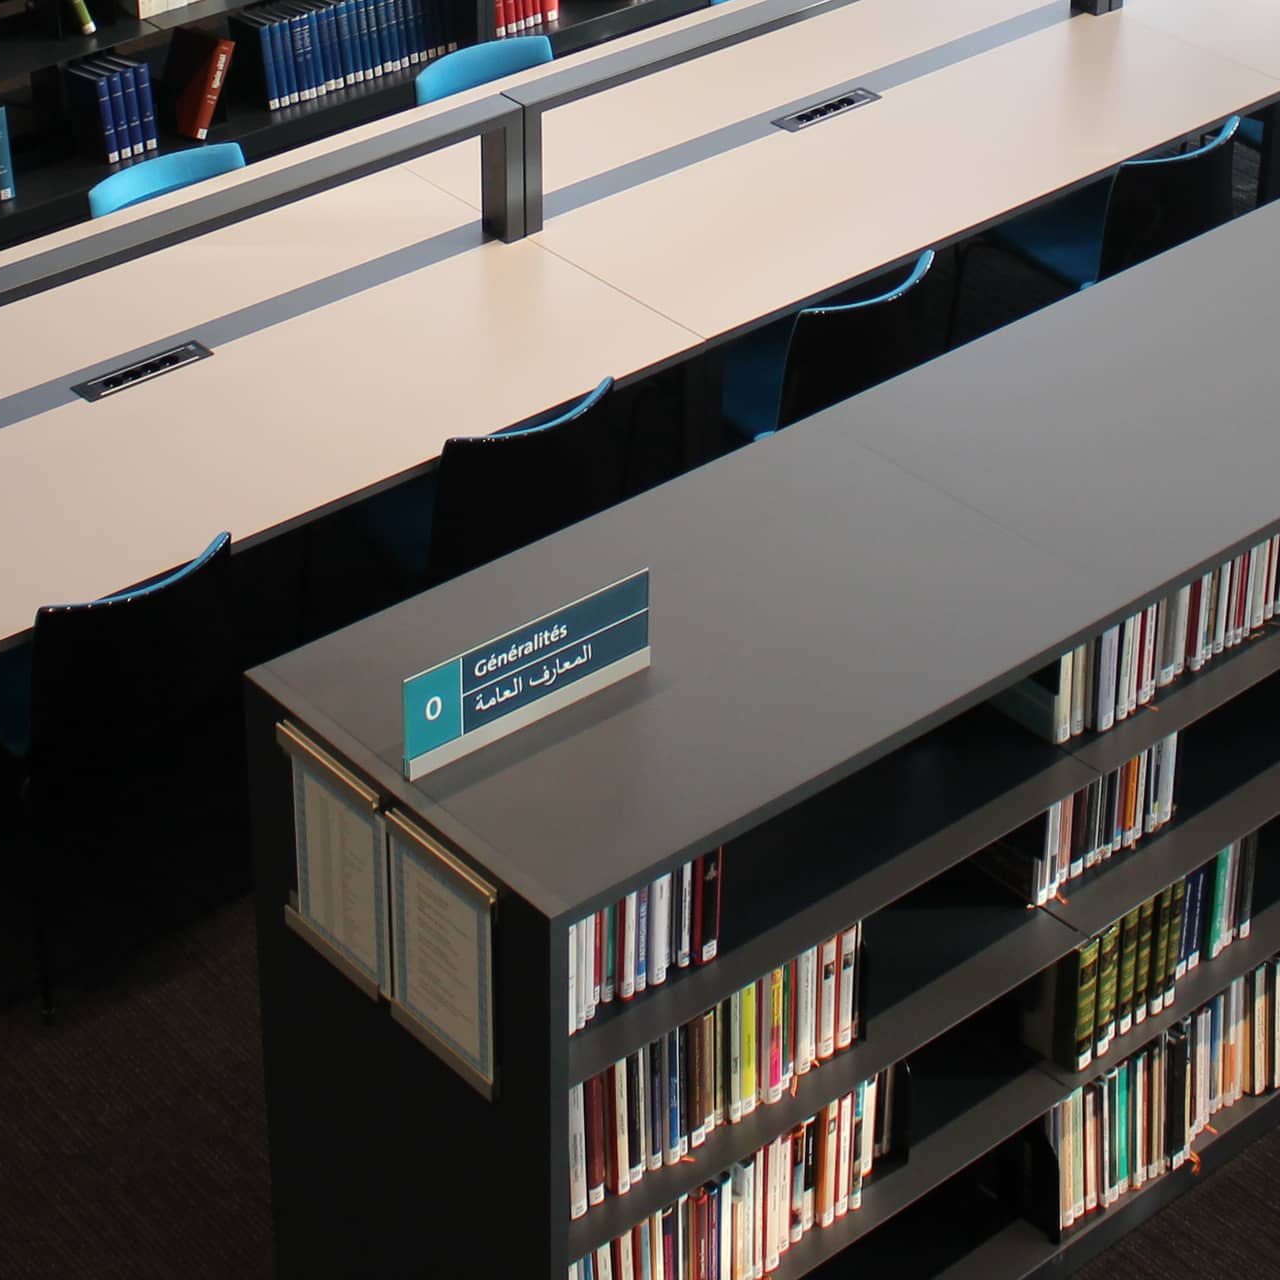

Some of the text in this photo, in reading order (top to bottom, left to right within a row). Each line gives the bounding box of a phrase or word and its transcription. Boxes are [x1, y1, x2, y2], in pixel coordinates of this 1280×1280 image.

[473, 624, 568, 677] Généralités
[474, 643, 593, 712] المعارف العامة
[425, 695, 443, 721] 0
